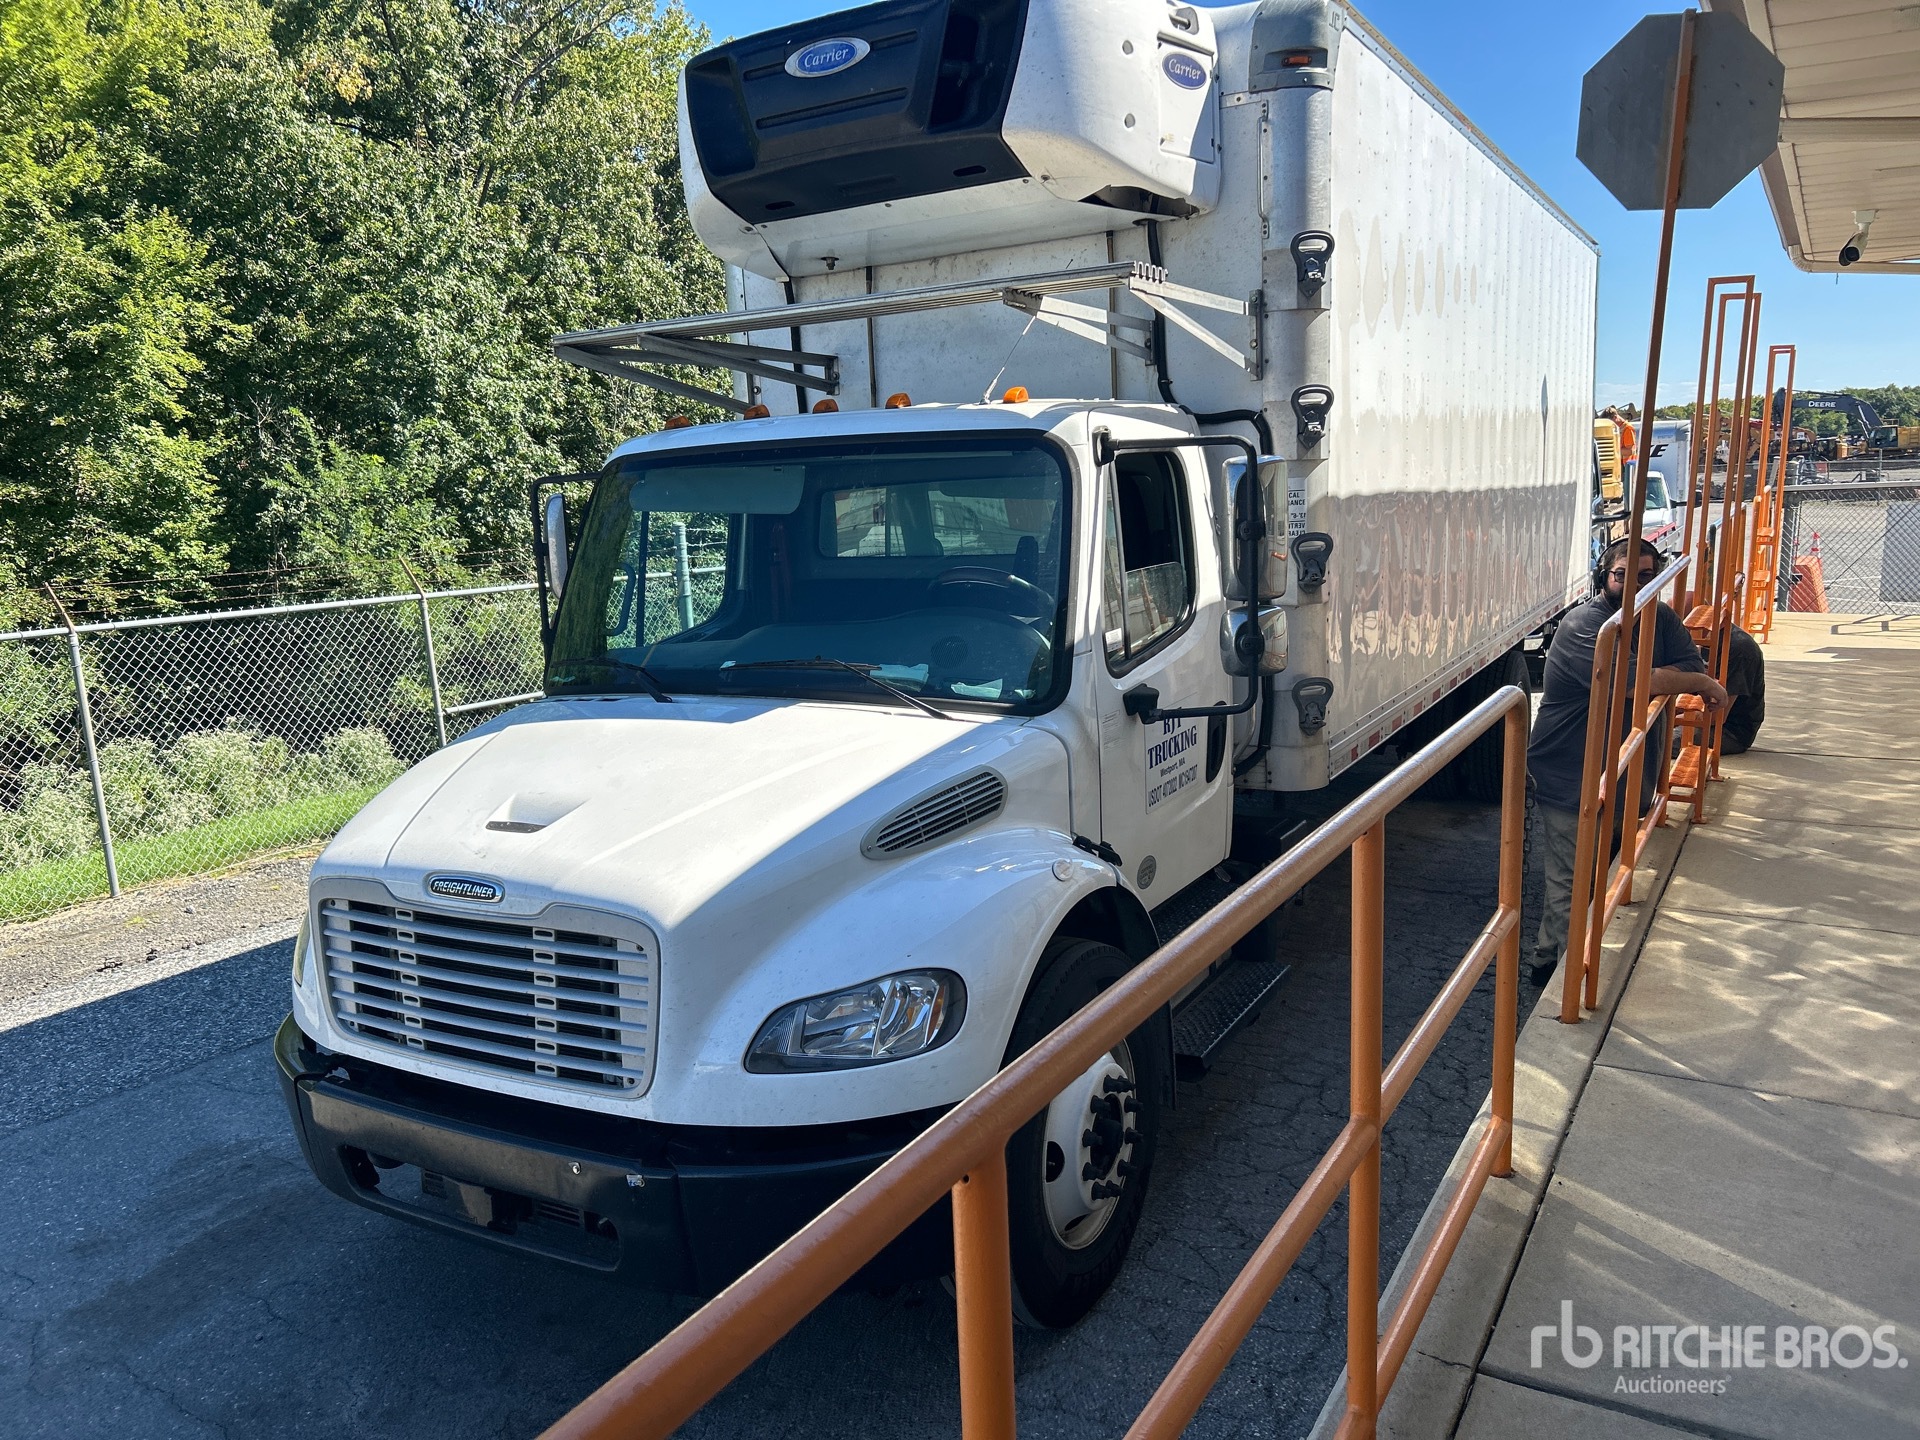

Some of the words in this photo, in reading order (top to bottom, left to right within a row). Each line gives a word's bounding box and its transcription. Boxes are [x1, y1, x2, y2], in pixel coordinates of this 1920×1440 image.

[804, 48, 849, 68] Carrier
[1168, 58, 1202, 80] Carrier
[1808, 400, 1837, 408] DEERE
[1147, 725, 1198, 770] TRUCKING
[432, 880, 494, 898] FREIGHTLINER
